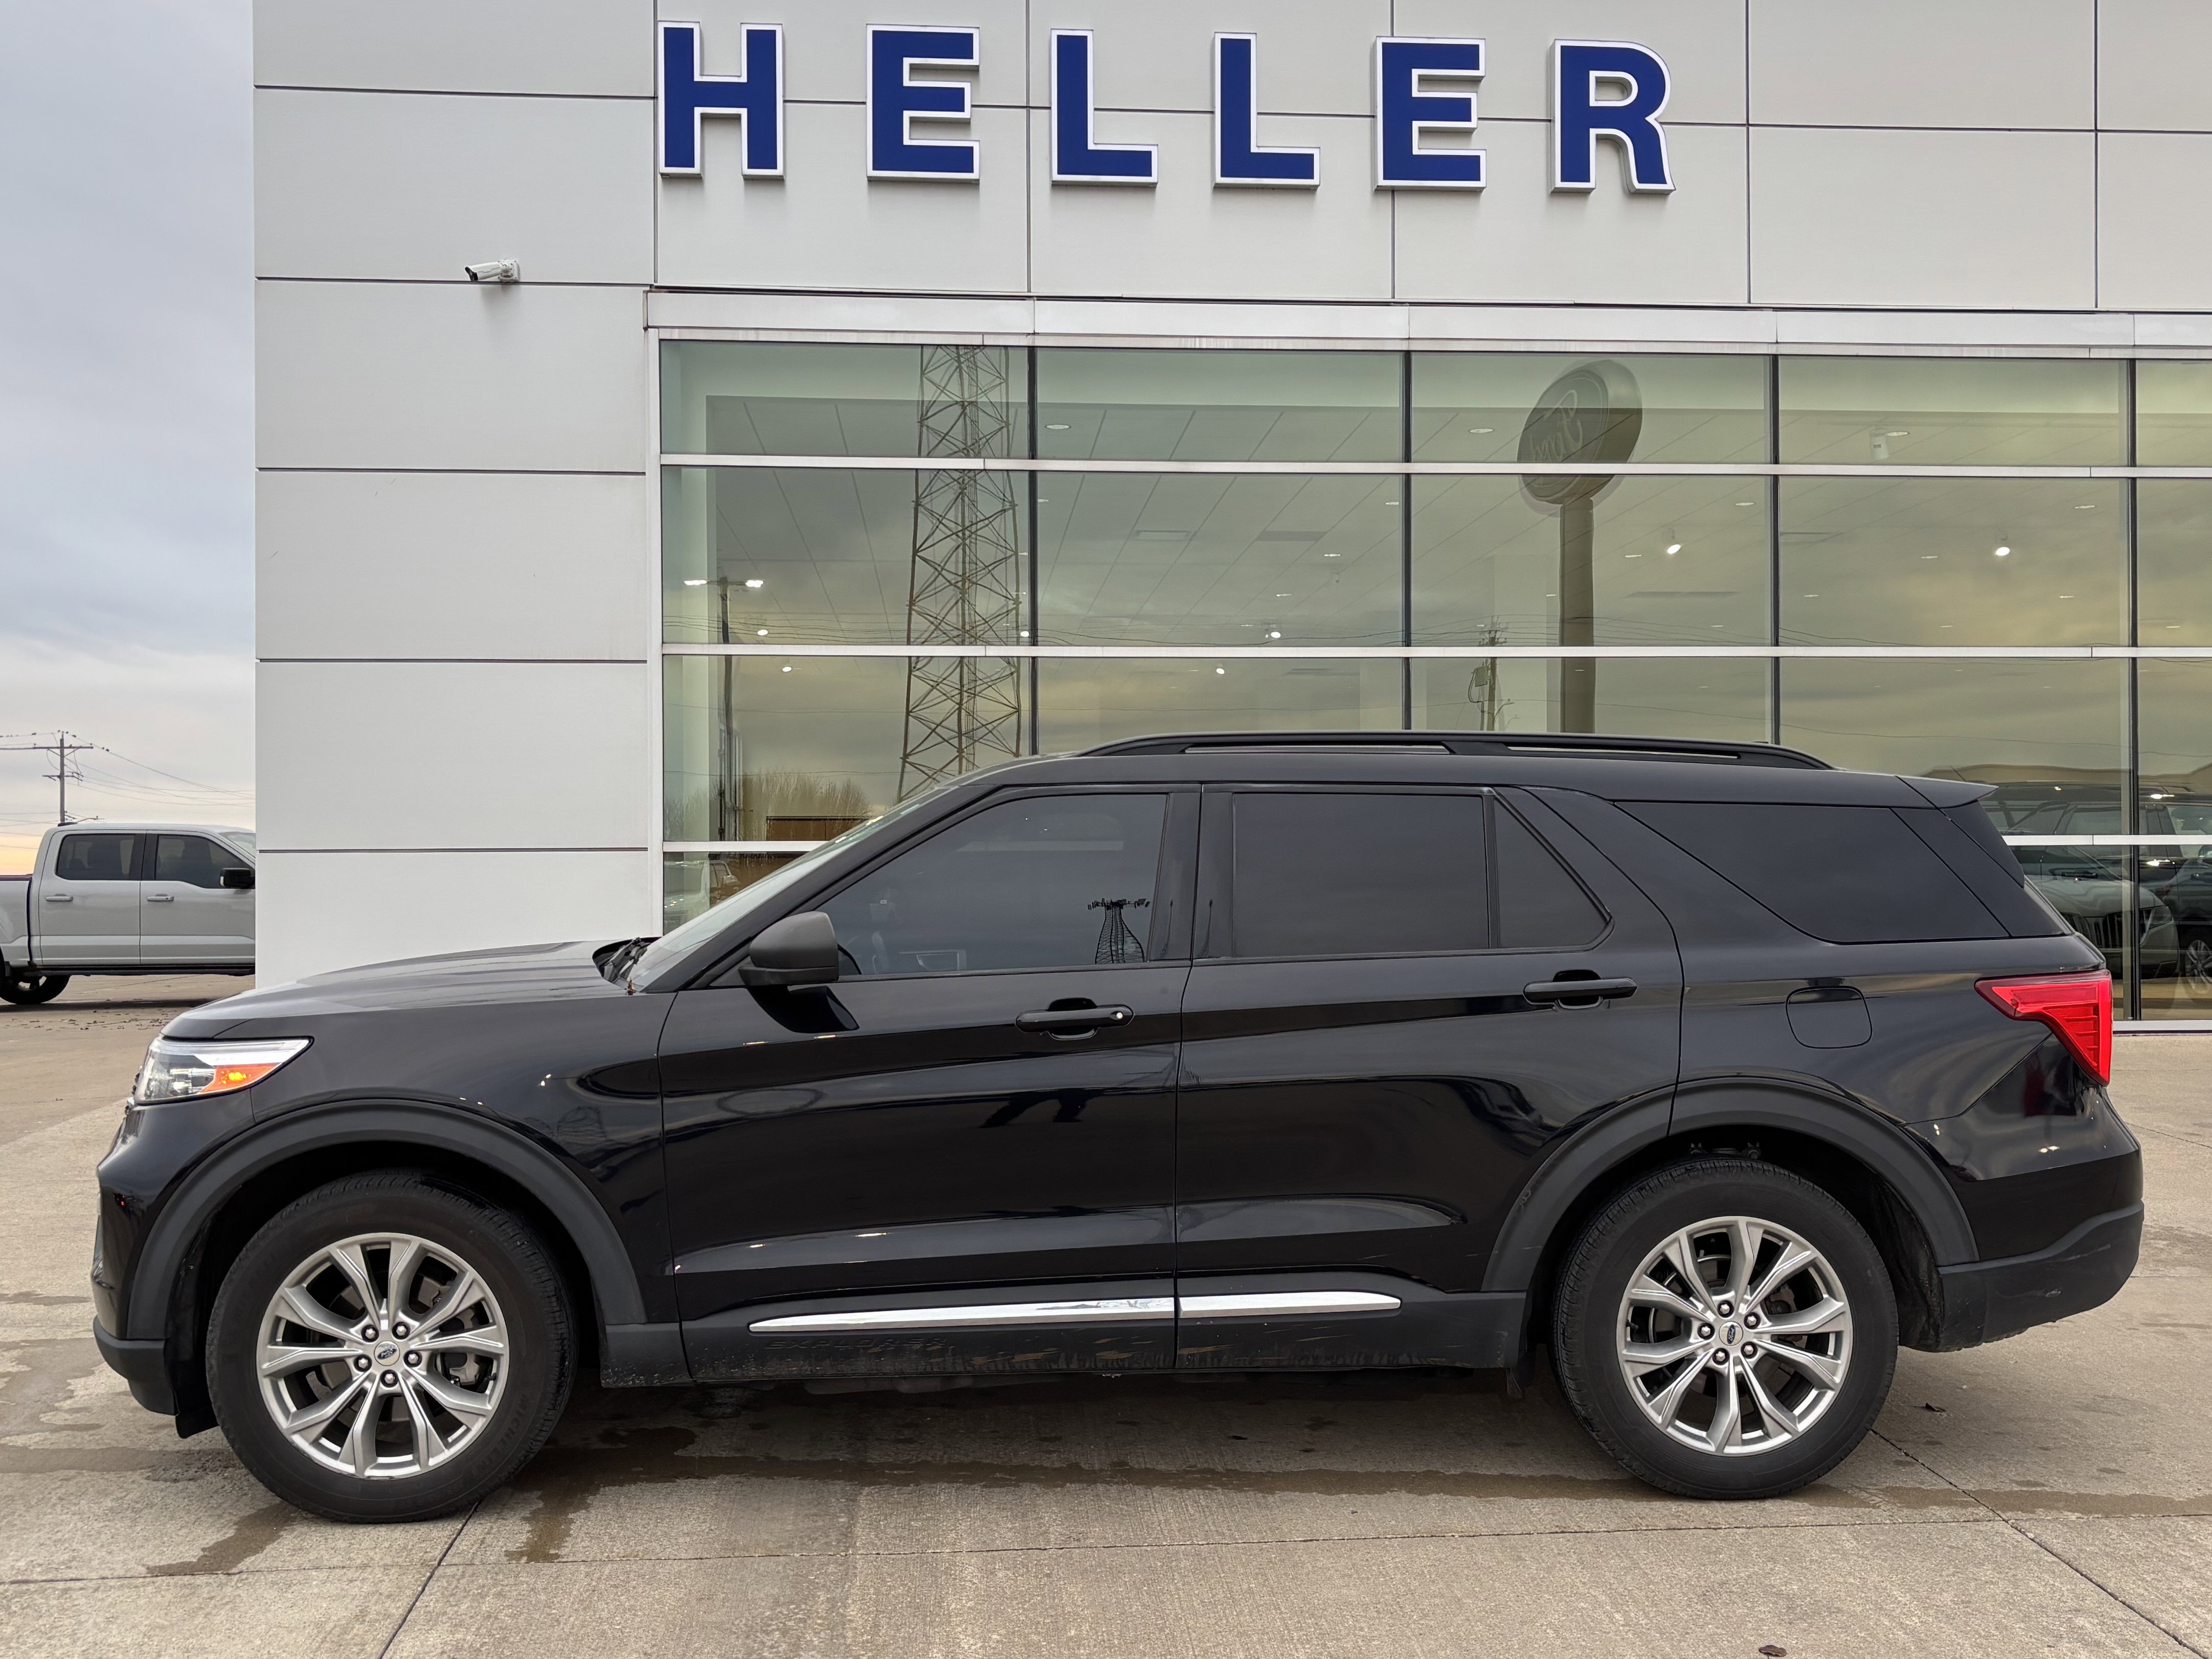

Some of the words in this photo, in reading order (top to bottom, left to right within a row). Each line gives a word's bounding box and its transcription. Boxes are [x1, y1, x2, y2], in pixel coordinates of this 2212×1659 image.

[657, 20, 1676, 195] HELLER
[765, 1337, 947, 1349] EXPLORER
[479, 1393, 529, 1469] MICHELIN
